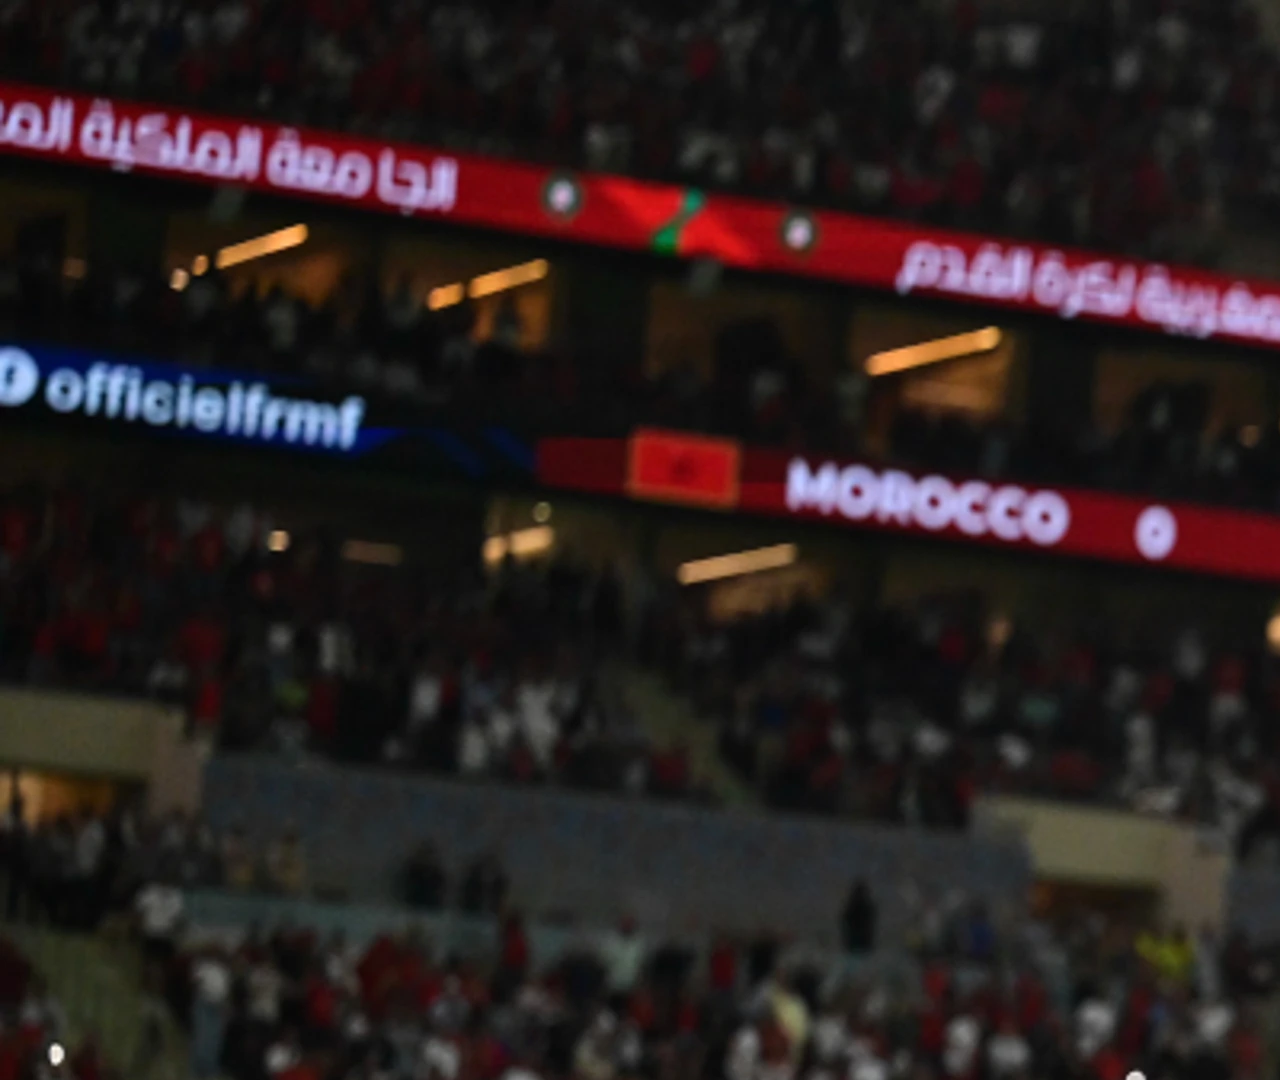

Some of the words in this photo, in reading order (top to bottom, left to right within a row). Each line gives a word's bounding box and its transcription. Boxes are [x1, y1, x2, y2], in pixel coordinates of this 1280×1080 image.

[44, 360, 367, 451] officielfrmf
[785, 455, 1070, 547] MOROCCO
[1134, 504, 1178, 561] 0
